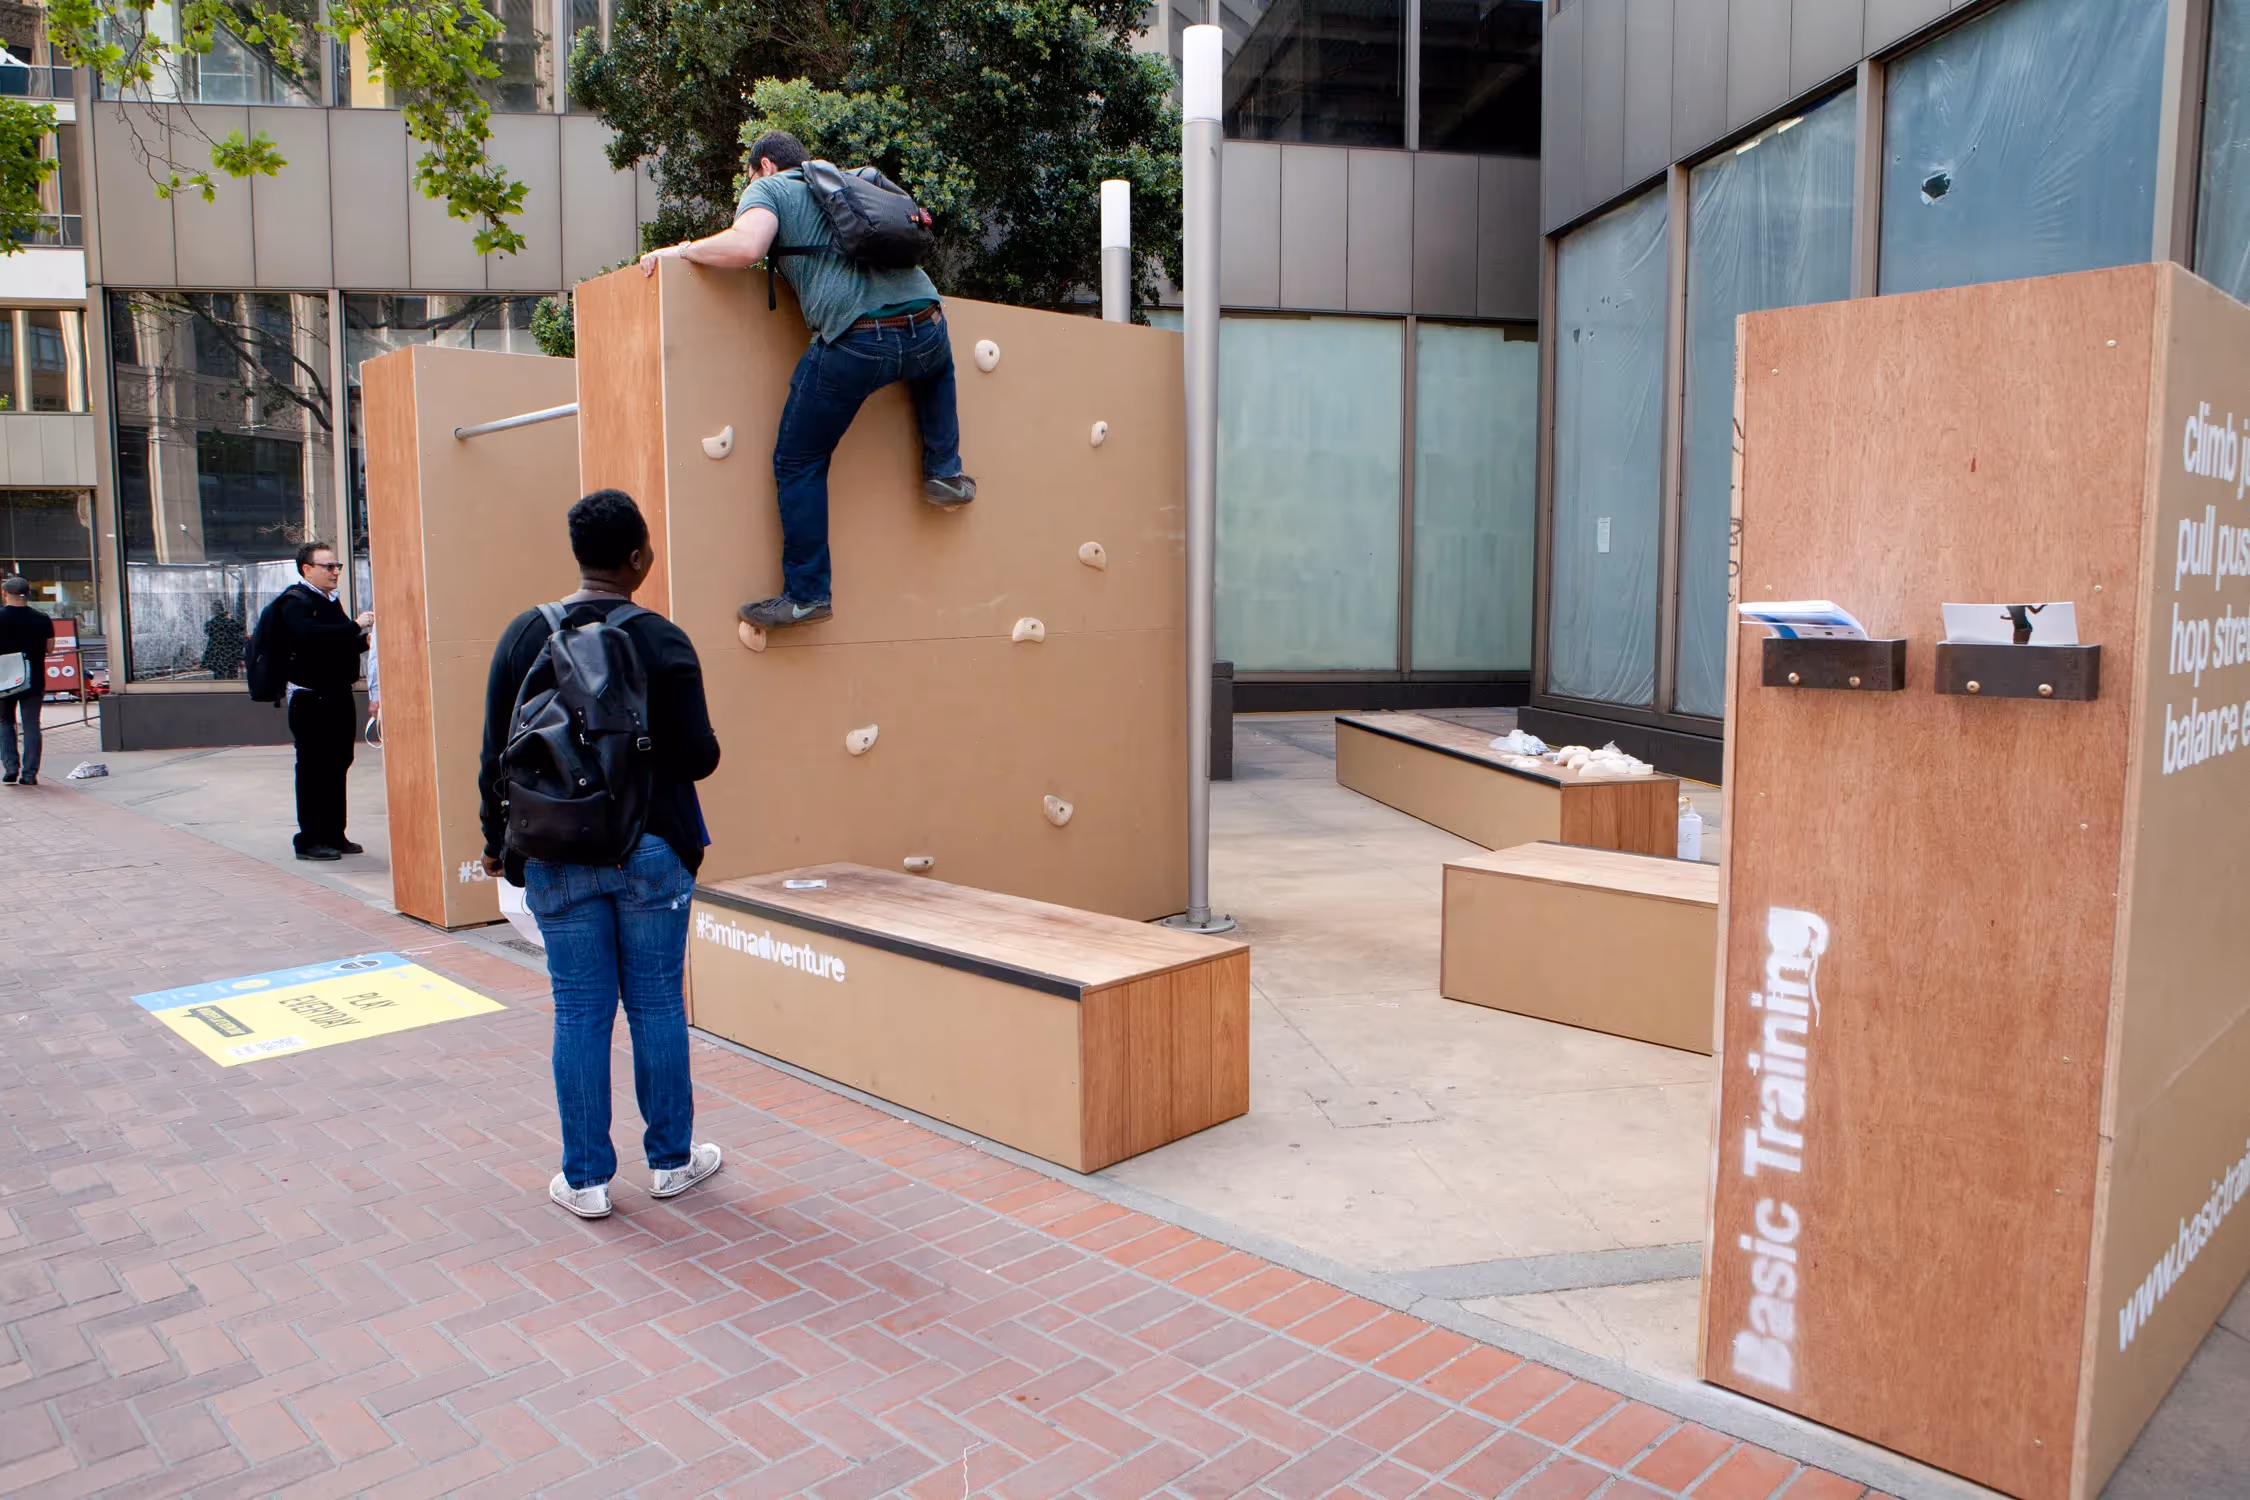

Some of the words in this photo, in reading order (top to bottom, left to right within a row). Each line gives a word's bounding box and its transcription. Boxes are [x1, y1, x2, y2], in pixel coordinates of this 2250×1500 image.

[2183, 401, 2237, 482] climb
[2175, 504, 2216, 591] pull
[2169, 602, 2210, 688] hop
[2162, 697, 2239, 775] balance
[696, 911, 846, 982] #5minadventure
[278, 994, 363, 1029] EVERYDAY
[342, 992, 400, 1011] PLAY
[1743, 906, 1829, 1177] Training
[1732, 1197, 1801, 1391] Basic
